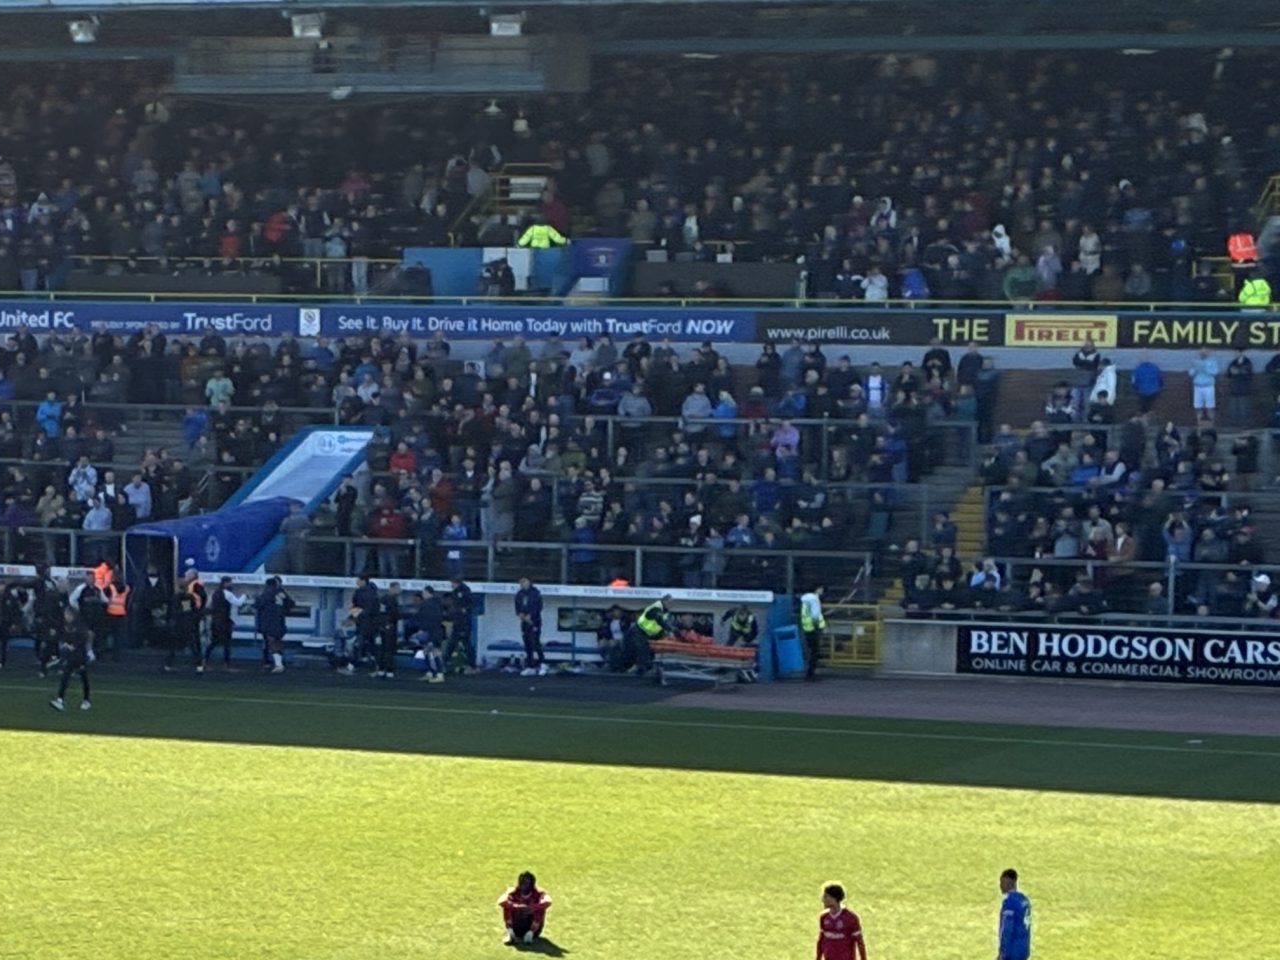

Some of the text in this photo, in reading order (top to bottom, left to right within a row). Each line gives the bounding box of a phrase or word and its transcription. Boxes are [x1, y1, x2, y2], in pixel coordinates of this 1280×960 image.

[53, 312, 75, 328] FC
[183, 312, 272, 331] TrustFord
[338, 316, 363, 329] See
[383, 316, 410, 331] Buy
[428, 317, 464, 331] Drive
[481, 318, 523, 332] Home
[526, 317, 568, 335] Today
[570, 318, 602, 333] with
[605, 318, 682, 334] TrustFord
[685, 319, 735, 335] NOW
[767, 325, 891, 342] www.pirelli.co.uk
[933, 318, 989, 341] THE
[1014, 319, 1108, 342] PIRELLI
[1133, 320, 1239, 343] FAMILY
[970, 630, 1280, 665] BEN HODGSON CARS
[972, 656, 1280, 681] ONLINE CAR & COMMERCIAL SHOWROOM
